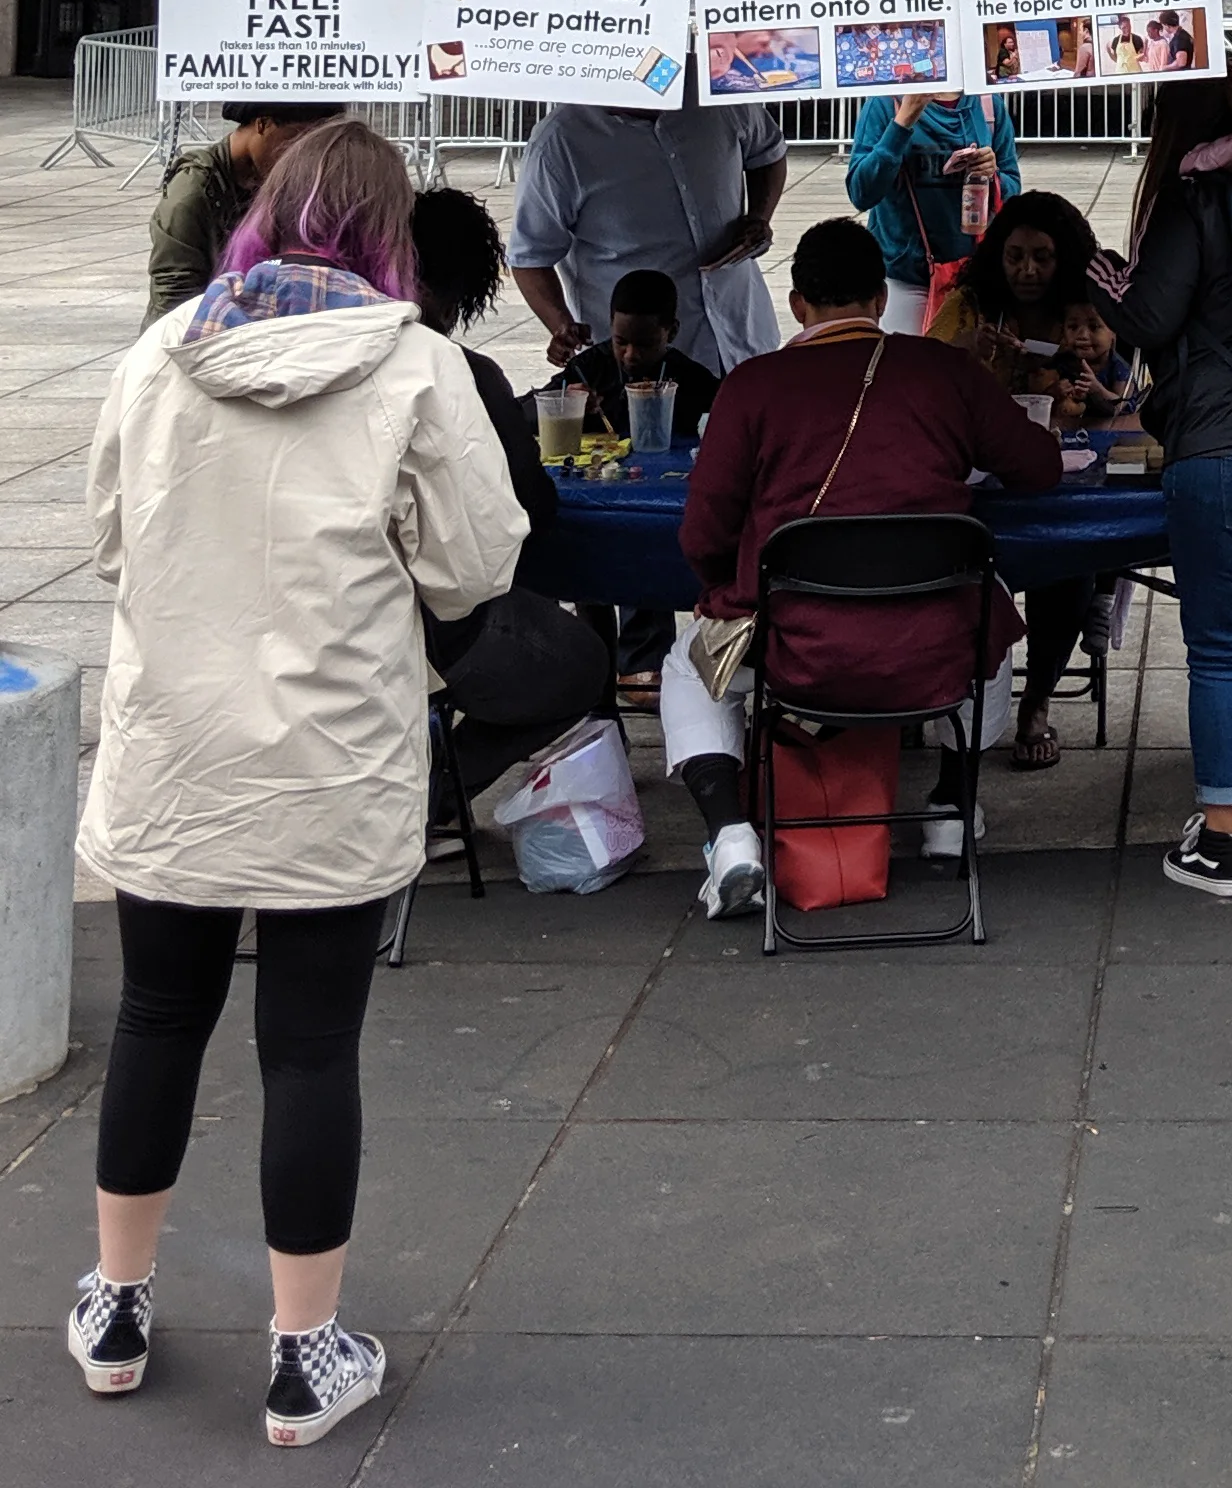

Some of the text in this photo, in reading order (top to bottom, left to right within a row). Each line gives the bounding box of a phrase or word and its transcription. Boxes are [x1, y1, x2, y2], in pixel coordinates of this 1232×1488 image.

[704, 0, 800, 29] pattern
[976, 0, 1008, 16] the
[247, 14, 341, 39] FAST!
[456, 6, 651, 36] paper pattern!
[219, 40, 366, 52] (takes less than 10 minutes)
[539, 41, 567, 53] are
[571, 42, 646, 59] complex
[164, 53, 421, 79] FAMILY-FRIENDLY!
[470, 58, 521, 74] others
[527, 63, 554, 76] are
[558, 65, 577, 78] so
[180, 79, 403, 92] (great spot to take a mini-break with kids)
